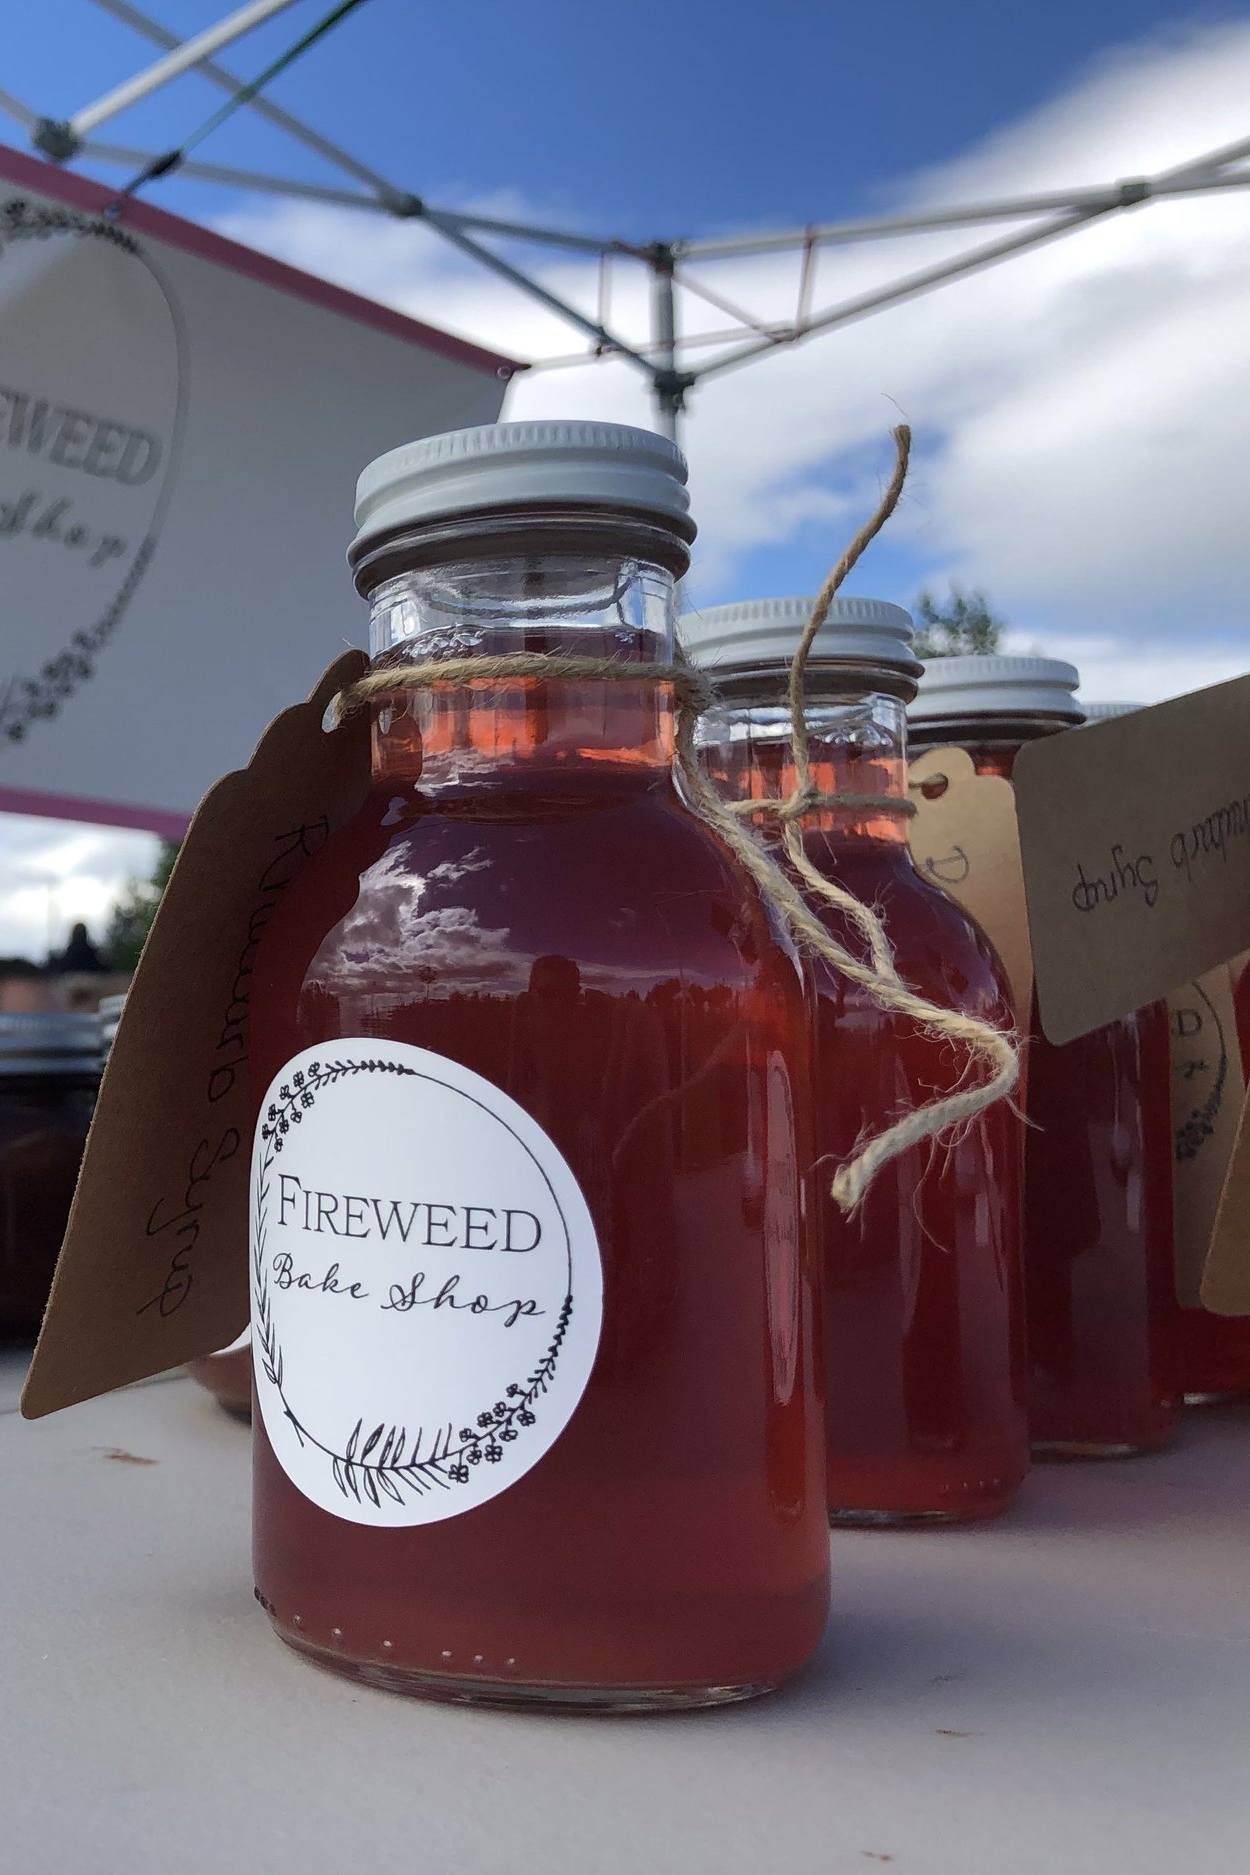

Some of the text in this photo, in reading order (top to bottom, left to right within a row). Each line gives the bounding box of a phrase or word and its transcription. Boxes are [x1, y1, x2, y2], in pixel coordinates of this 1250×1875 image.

[1071, 844, 1159, 912] Syrup
[136, 813, 330, 1319] Ruarb Syrup
[277, 1173, 543, 1253] FIREWEED
[272, 1252, 546, 1329] Bake Shop
